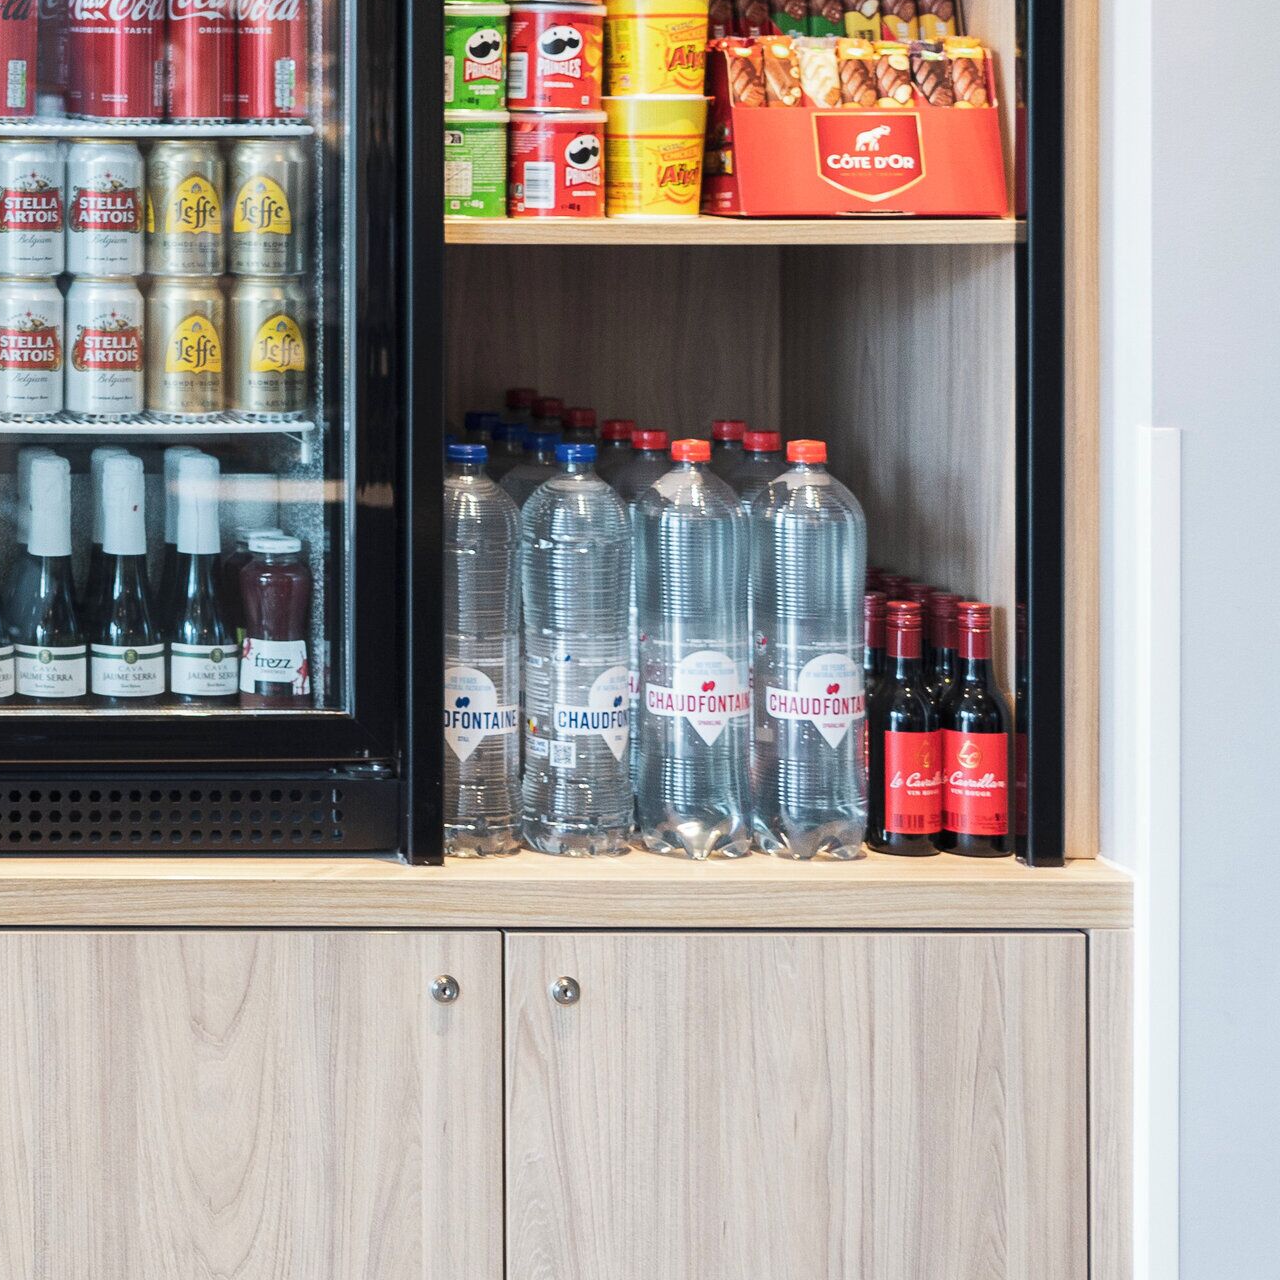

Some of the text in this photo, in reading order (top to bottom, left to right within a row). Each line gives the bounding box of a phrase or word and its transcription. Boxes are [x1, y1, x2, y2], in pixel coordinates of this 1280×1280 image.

[124, 26, 153, 34] TASTE
[826, 153, 915, 170] CÔTE D'OR
[4, 197, 58, 209] STELLA
[79, 197, 134, 210] STELLA
[3, 210, 59, 223] ARTOIS
[78, 210, 135, 223] ARTOIS
[175, 195, 217, 229] Leffe
[240, 195, 285, 229] Leffe
[0, 335, 54, 348] STELLA
[84, 336, 138, 348] STELLA
[0, 349, 55, 362] ARTOIS
[83, 350, 138, 363] ARTOIS
[175, 335, 217, 368] Leffe
[260, 334, 301, 368] Leffe
[254, 652, 294, 670] frezz
[45, 673, 74, 682] SERRA
[102, 672, 158, 681] JAUME SERRA
